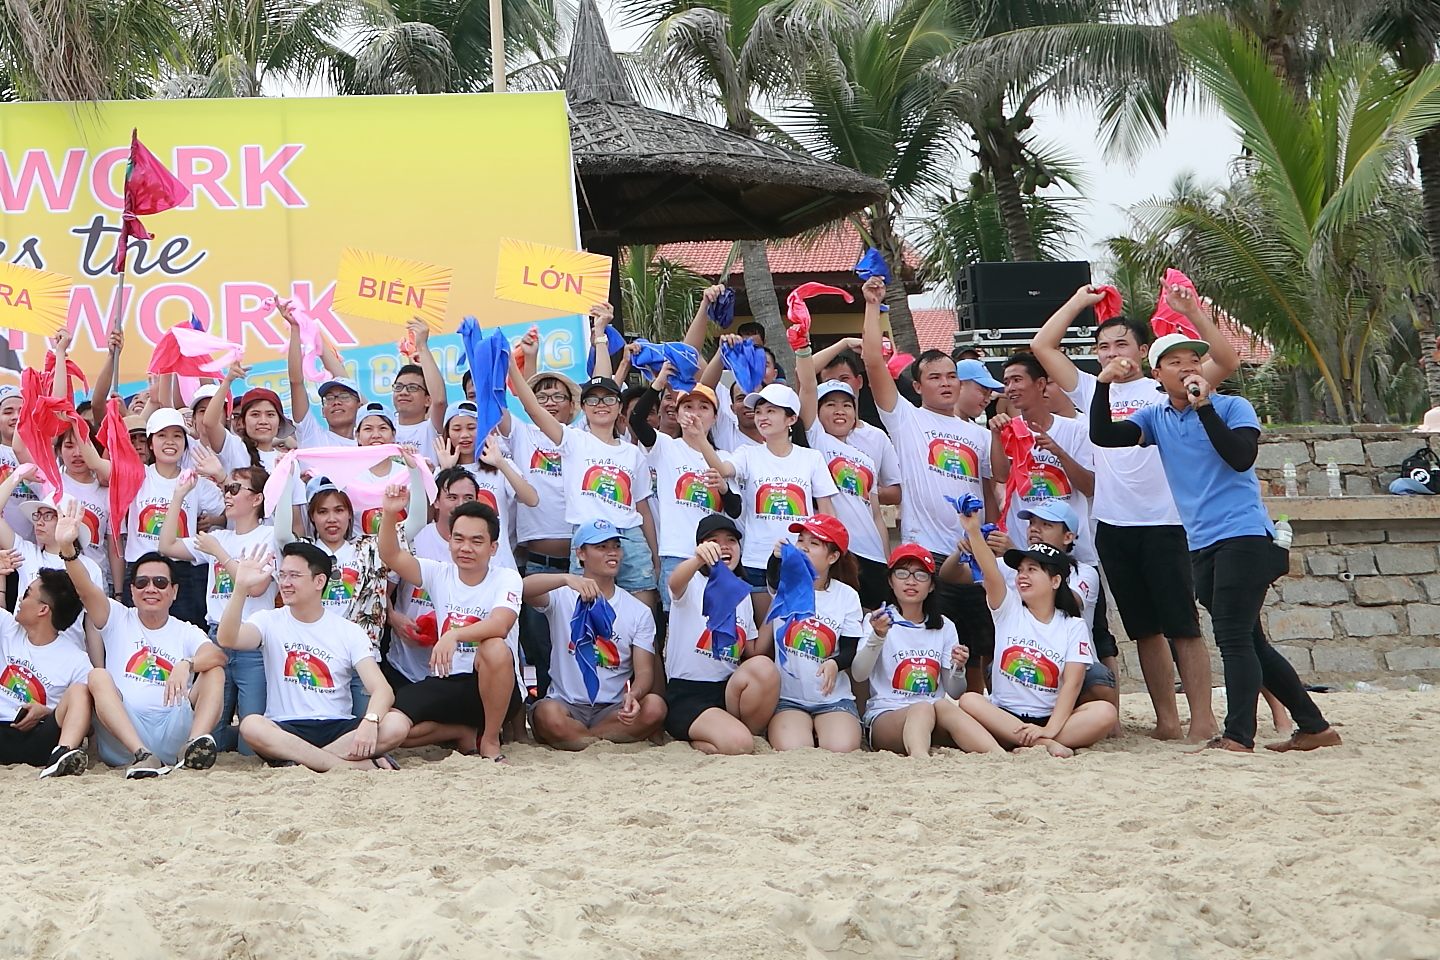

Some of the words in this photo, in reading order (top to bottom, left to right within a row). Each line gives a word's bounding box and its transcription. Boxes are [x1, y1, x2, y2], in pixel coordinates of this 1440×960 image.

[523, 265, 583, 295] LỚN
[358, 276, 427, 309] BIỂN
[925, 429, 981, 452] TEAMWORK
[753, 475, 810, 490] TEAMWORK
[283, 641, 335, 664] EAMWORK
[892, 649, 942, 664] TEAMWOR
[1006, 636, 1066, 667] TEAMWORK
